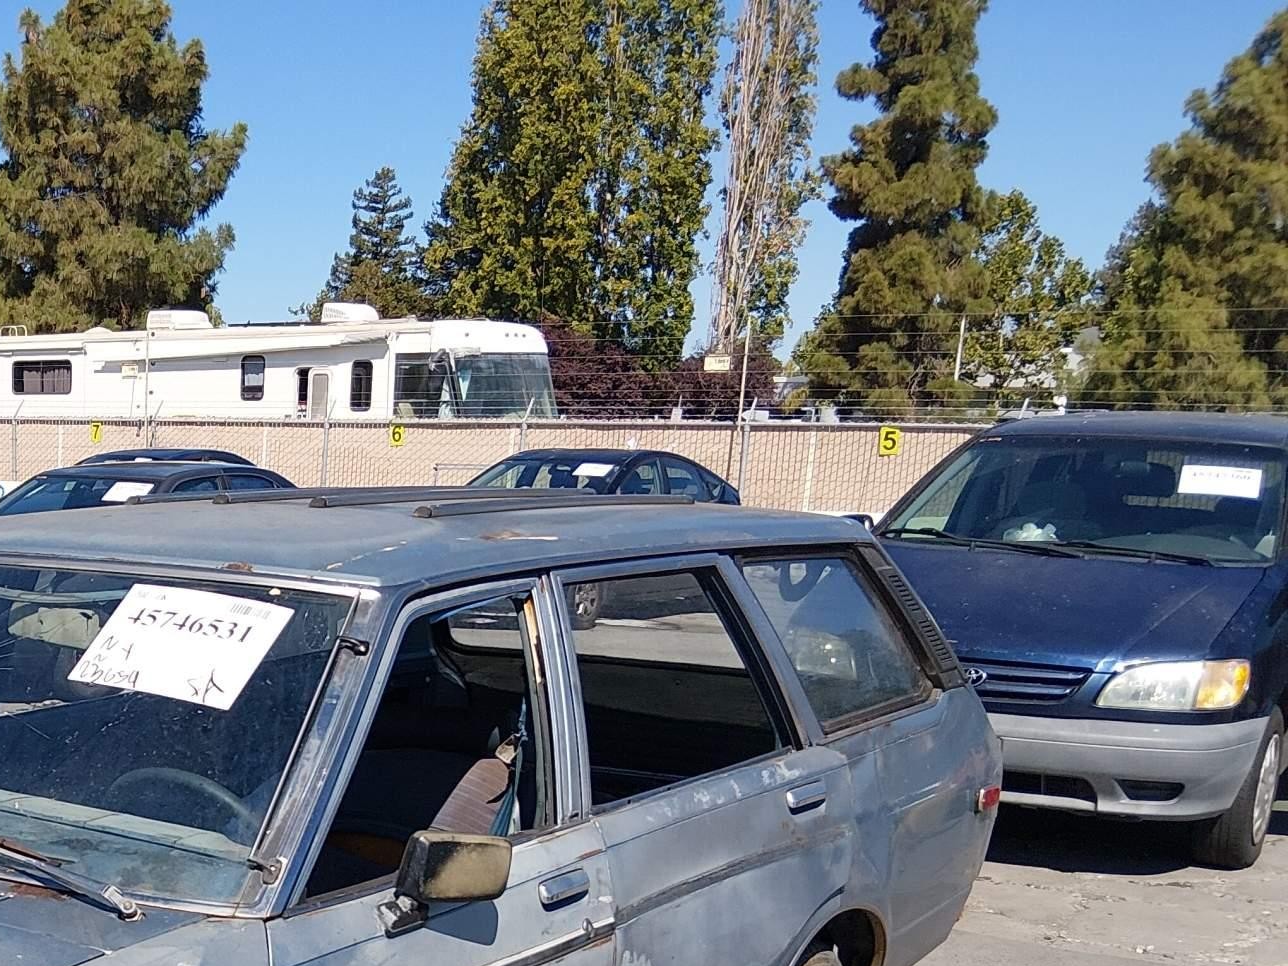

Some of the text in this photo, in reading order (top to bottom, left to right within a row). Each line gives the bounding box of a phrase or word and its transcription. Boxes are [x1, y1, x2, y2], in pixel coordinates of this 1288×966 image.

[92, 424, 100, 439] 7
[392, 425, 402, 442] 6
[882, 430, 897, 451] 5
[128, 607, 254, 643] 45746531
